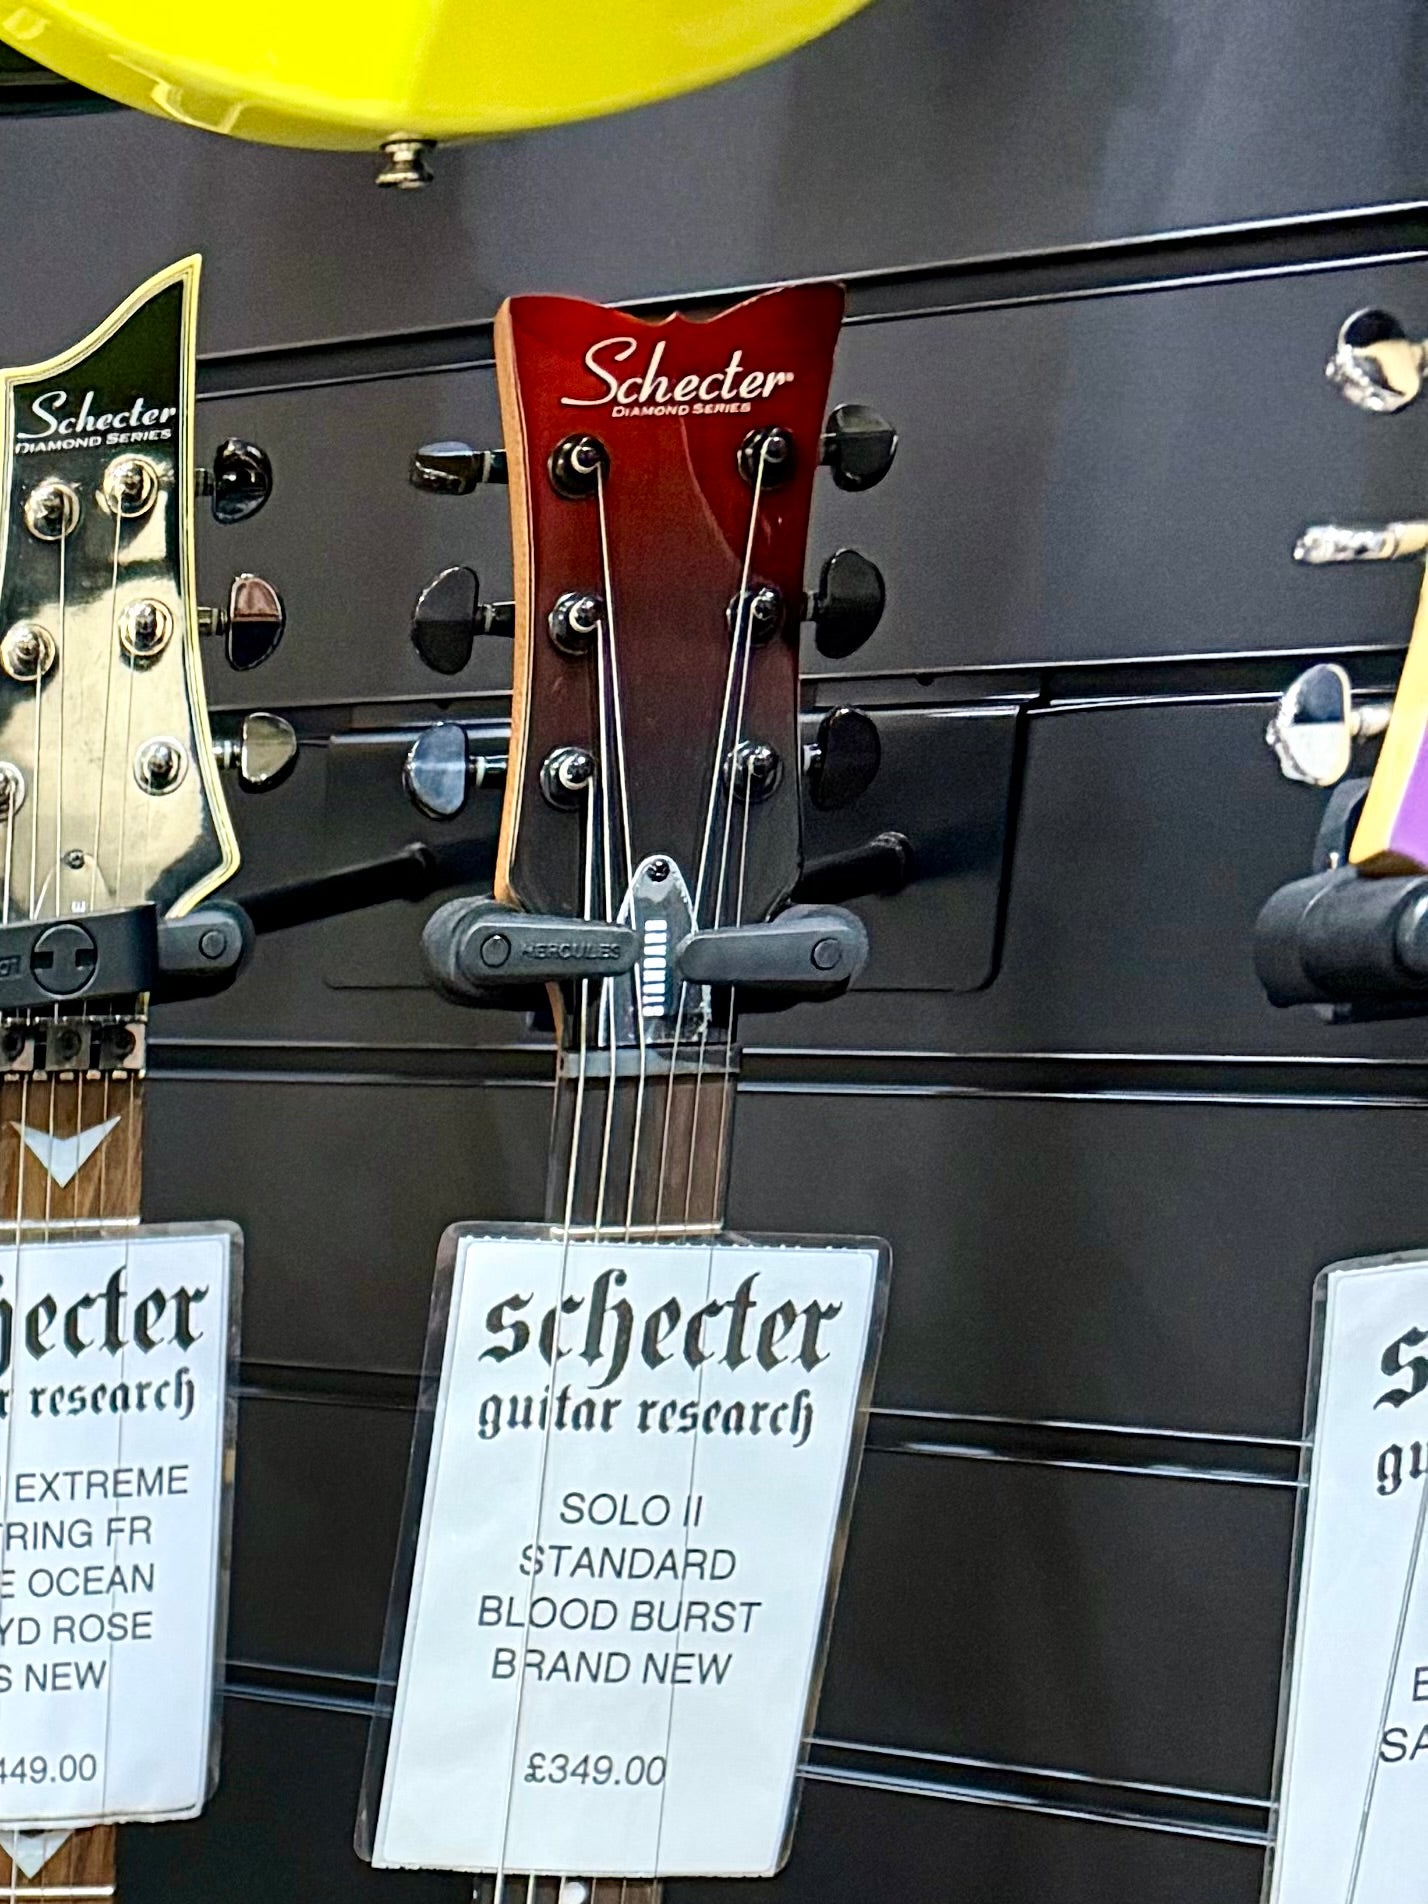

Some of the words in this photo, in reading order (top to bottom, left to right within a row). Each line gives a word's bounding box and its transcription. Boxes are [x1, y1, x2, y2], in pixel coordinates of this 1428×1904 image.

[560, 337, 786, 406] Schecter
[16, 390, 177, 438] Schecter
[693, 402, 751, 414] SERIES
[15, 436, 102, 454] DIAMOND
[106, 429, 172, 445] SERIES
[477, 1265, 845, 1392] schecter
[29, 1365, 197, 1421] research
[476, 1383, 624, 1442] guitar
[634, 1387, 814, 1449] research
[13, 1463, 191, 1504] EXTREME
[558, 1490, 673, 1528] SOLO
[682, 1494, 704, 1529] II
[105, 1514, 154, 1549] FR
[27, 1562, 156, 1599] OCEAN
[518, 1543, 737, 1583] STANDARD
[52, 1610, 155, 1646] ROSE
[476, 1594, 619, 1633] BLOOD
[628, 1600, 763, 1635] BURST
[24, 1659, 108, 1695] NEW
[490, 1647, 632, 1686] BRAND
[641, 1651, 735, 1687] NEW
[522, 1752, 668, 1788] £349.00
